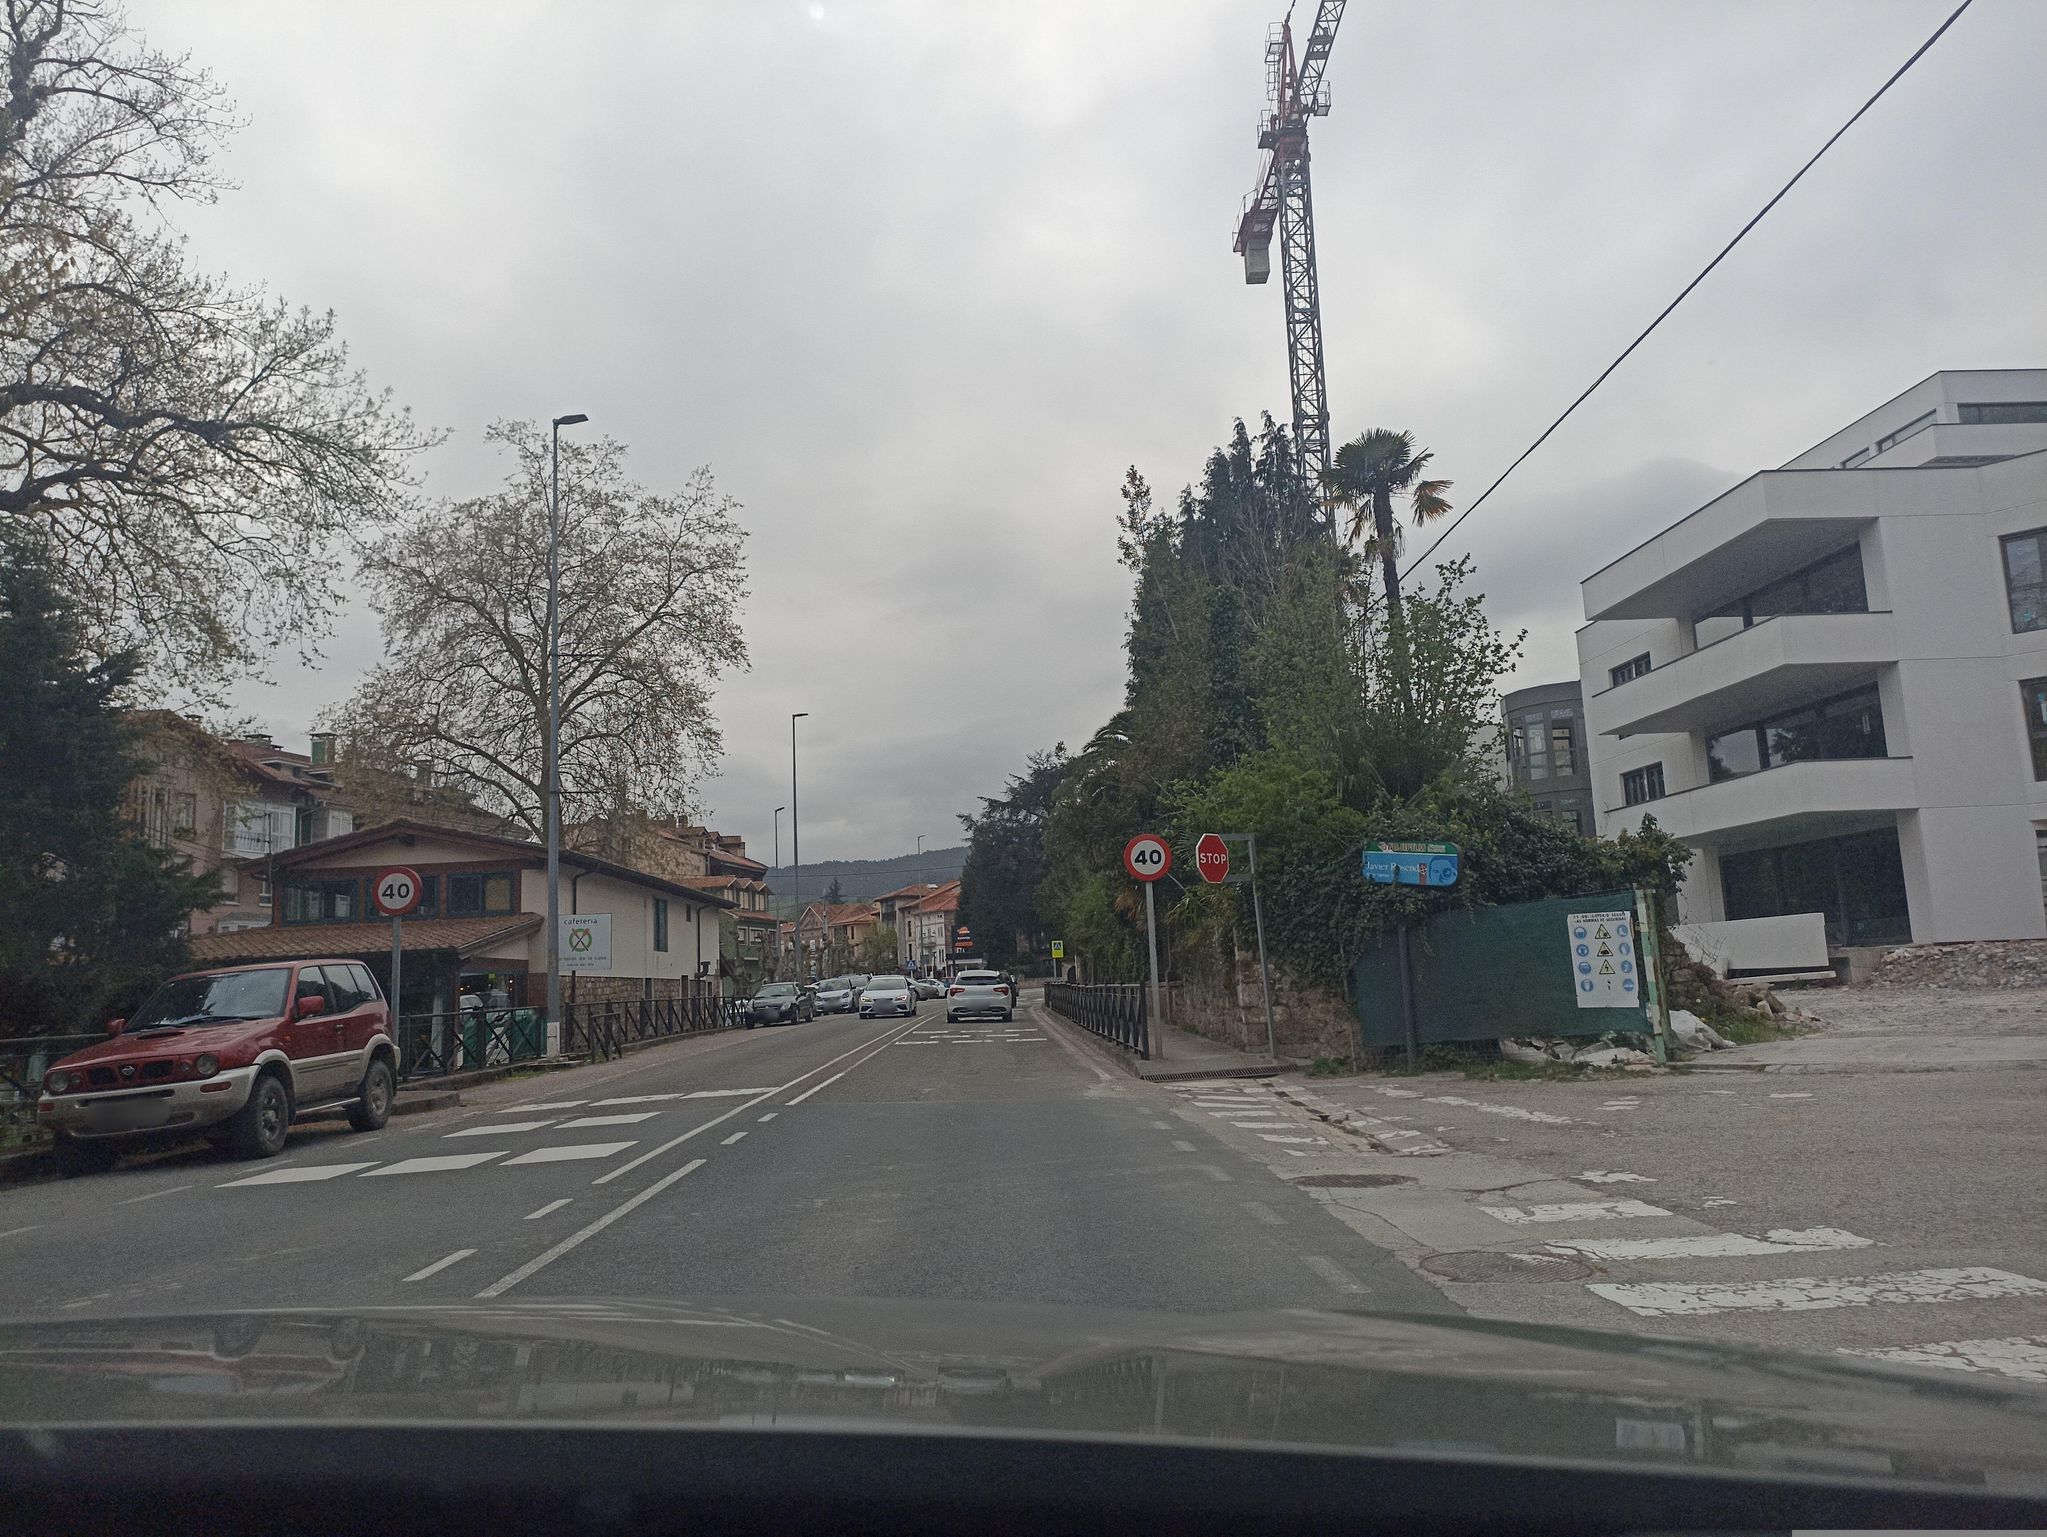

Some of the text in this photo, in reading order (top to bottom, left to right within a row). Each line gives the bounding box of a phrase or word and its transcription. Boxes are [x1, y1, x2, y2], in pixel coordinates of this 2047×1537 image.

[1134, 849, 1161, 865] 40
[1200, 853, 1226, 865] STOP
[1366, 861, 1388, 871] Javier
[381, 883, 410, 899] 40
